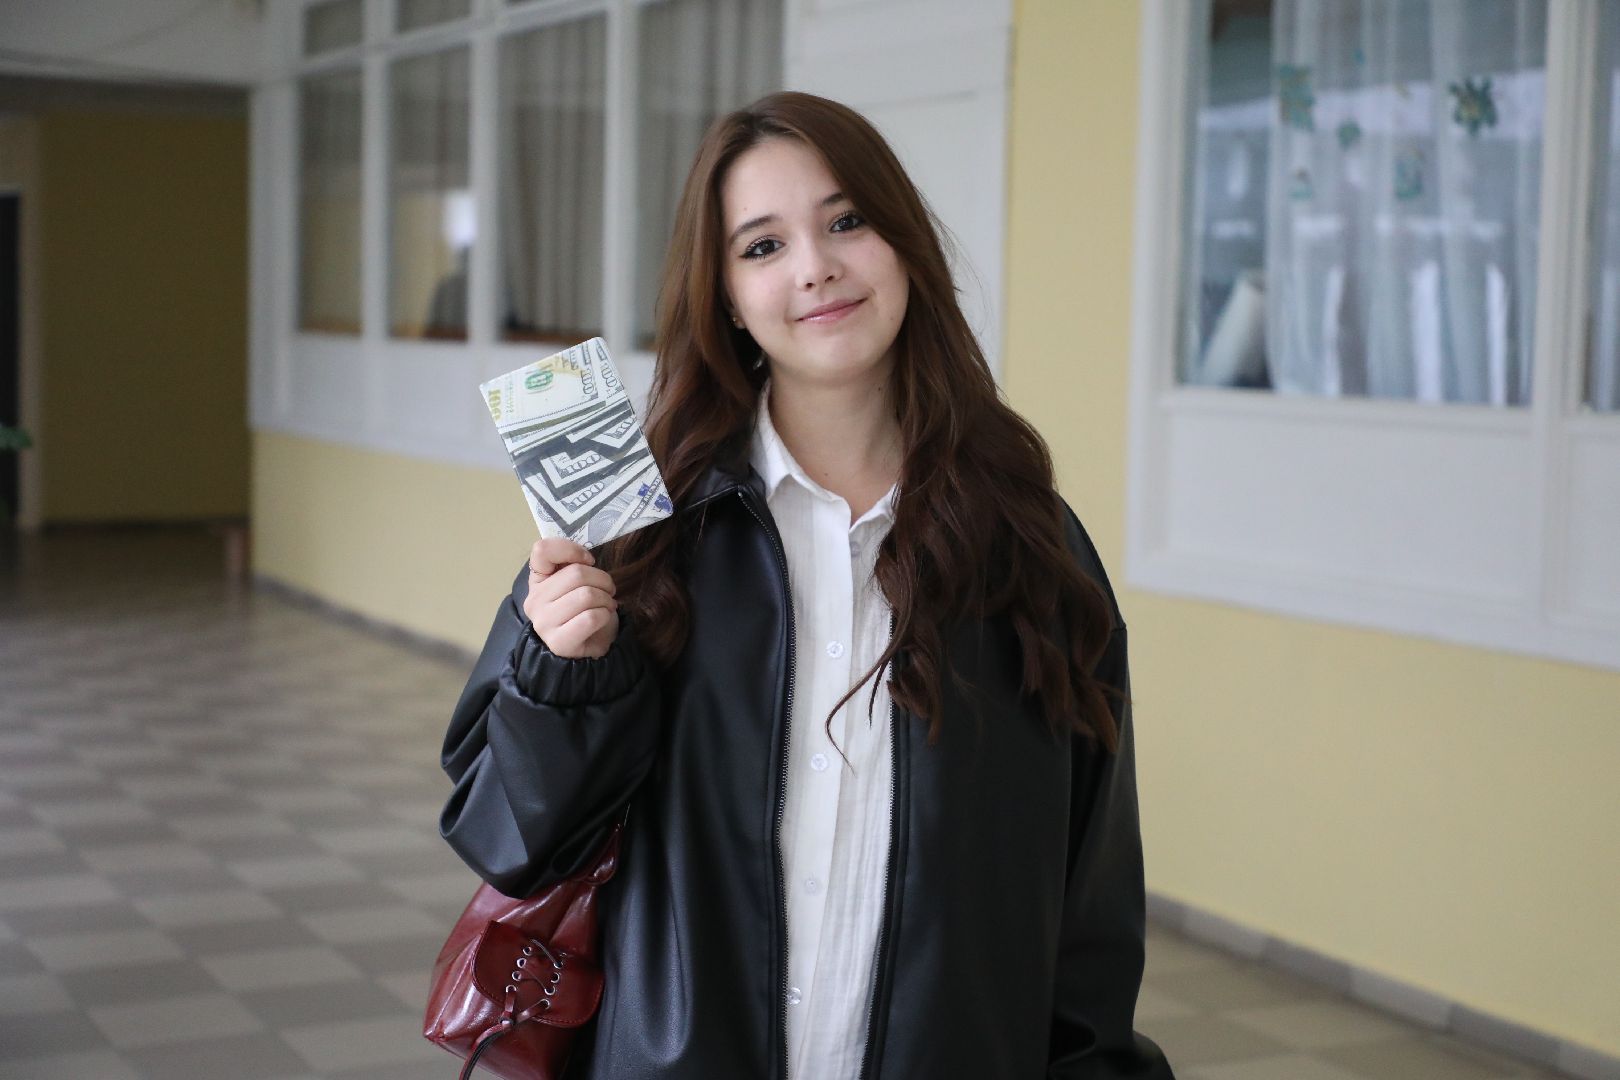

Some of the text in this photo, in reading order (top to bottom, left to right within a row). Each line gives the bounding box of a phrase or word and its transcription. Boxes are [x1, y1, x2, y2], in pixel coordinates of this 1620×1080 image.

[600, 362, 618, 388] 100
[563, 453, 602, 474] 100
[572, 481, 605, 506] 100
